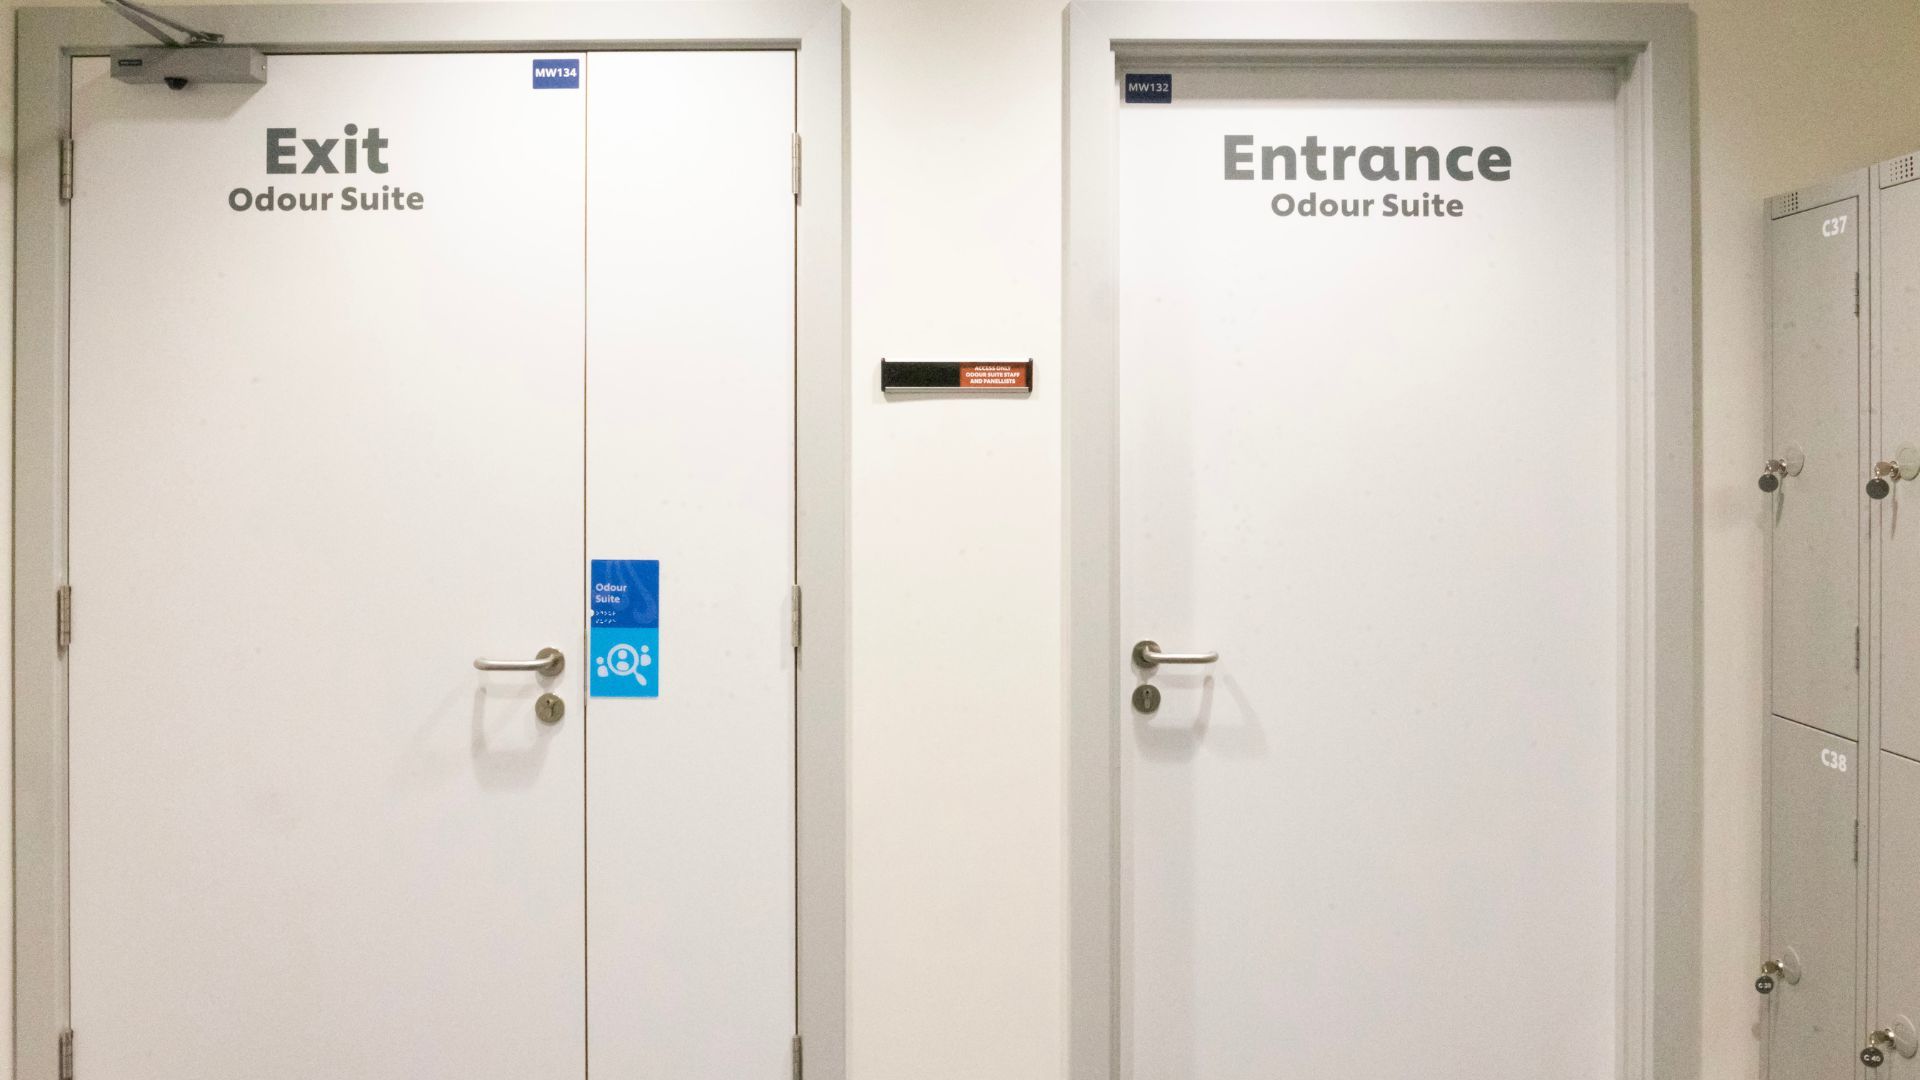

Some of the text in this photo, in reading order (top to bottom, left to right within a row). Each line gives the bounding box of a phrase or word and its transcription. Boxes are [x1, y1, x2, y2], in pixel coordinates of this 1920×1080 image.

[535, 67, 577, 78] MW134
[1128, 82, 1169, 92] MW132
[266, 123, 389, 174] Exit
[1224, 134, 1512, 182] Entrance
[228, 184, 425, 212] Odour Suite
[1271, 191, 1464, 217] Odour Suite
[1822, 215, 1847, 238] C37
[595, 583, 627, 592] Odour
[595, 595, 620, 603] Suite
[1821, 748, 1847, 772] C38
